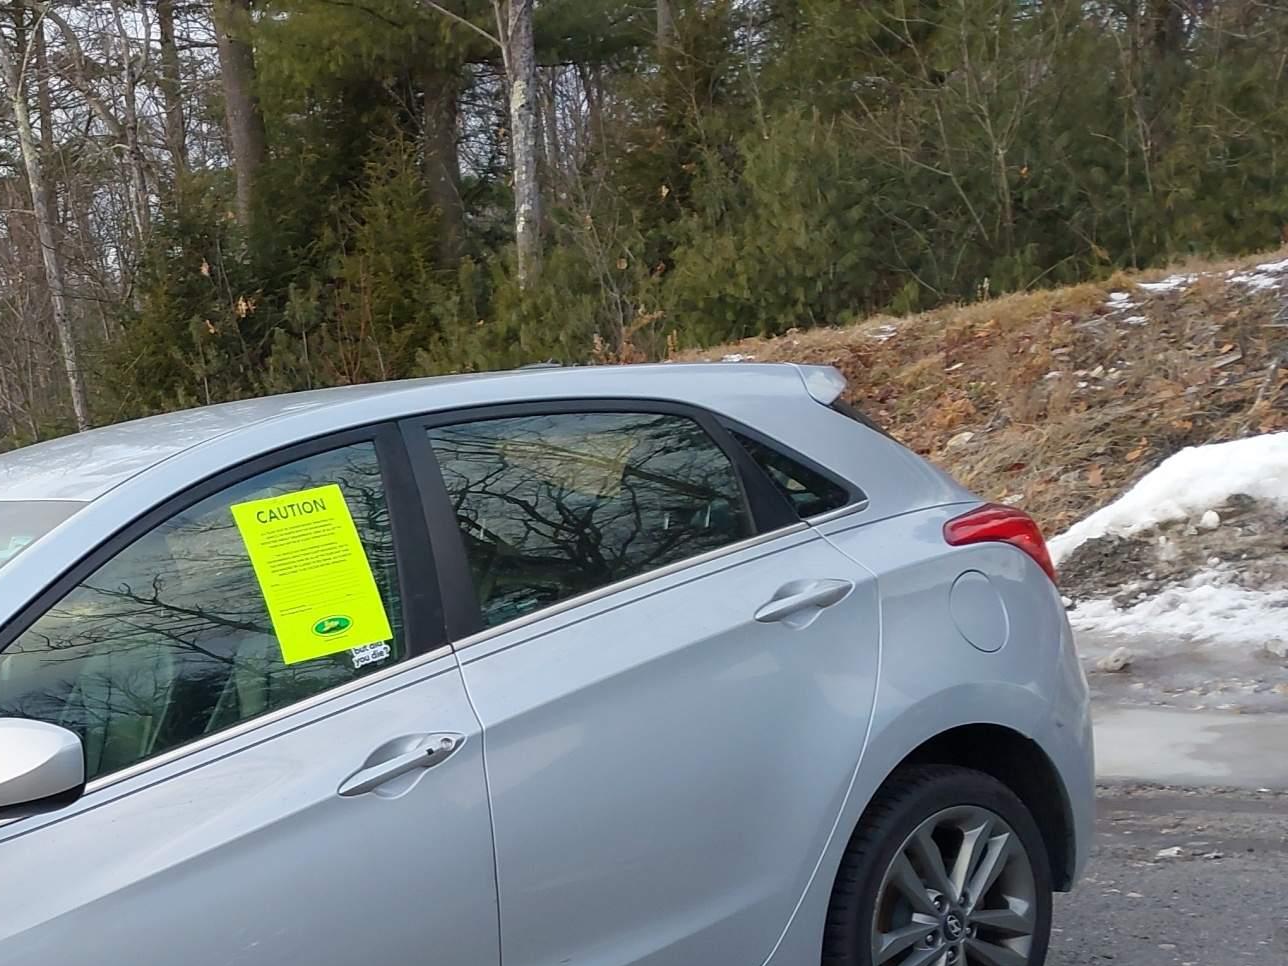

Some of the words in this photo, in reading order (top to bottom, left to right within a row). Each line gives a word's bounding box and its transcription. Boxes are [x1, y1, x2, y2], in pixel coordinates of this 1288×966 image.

[256, 498, 326, 524] CAUTION
[354, 655, 370, 667] you
[371, 646, 389, 660] die?
